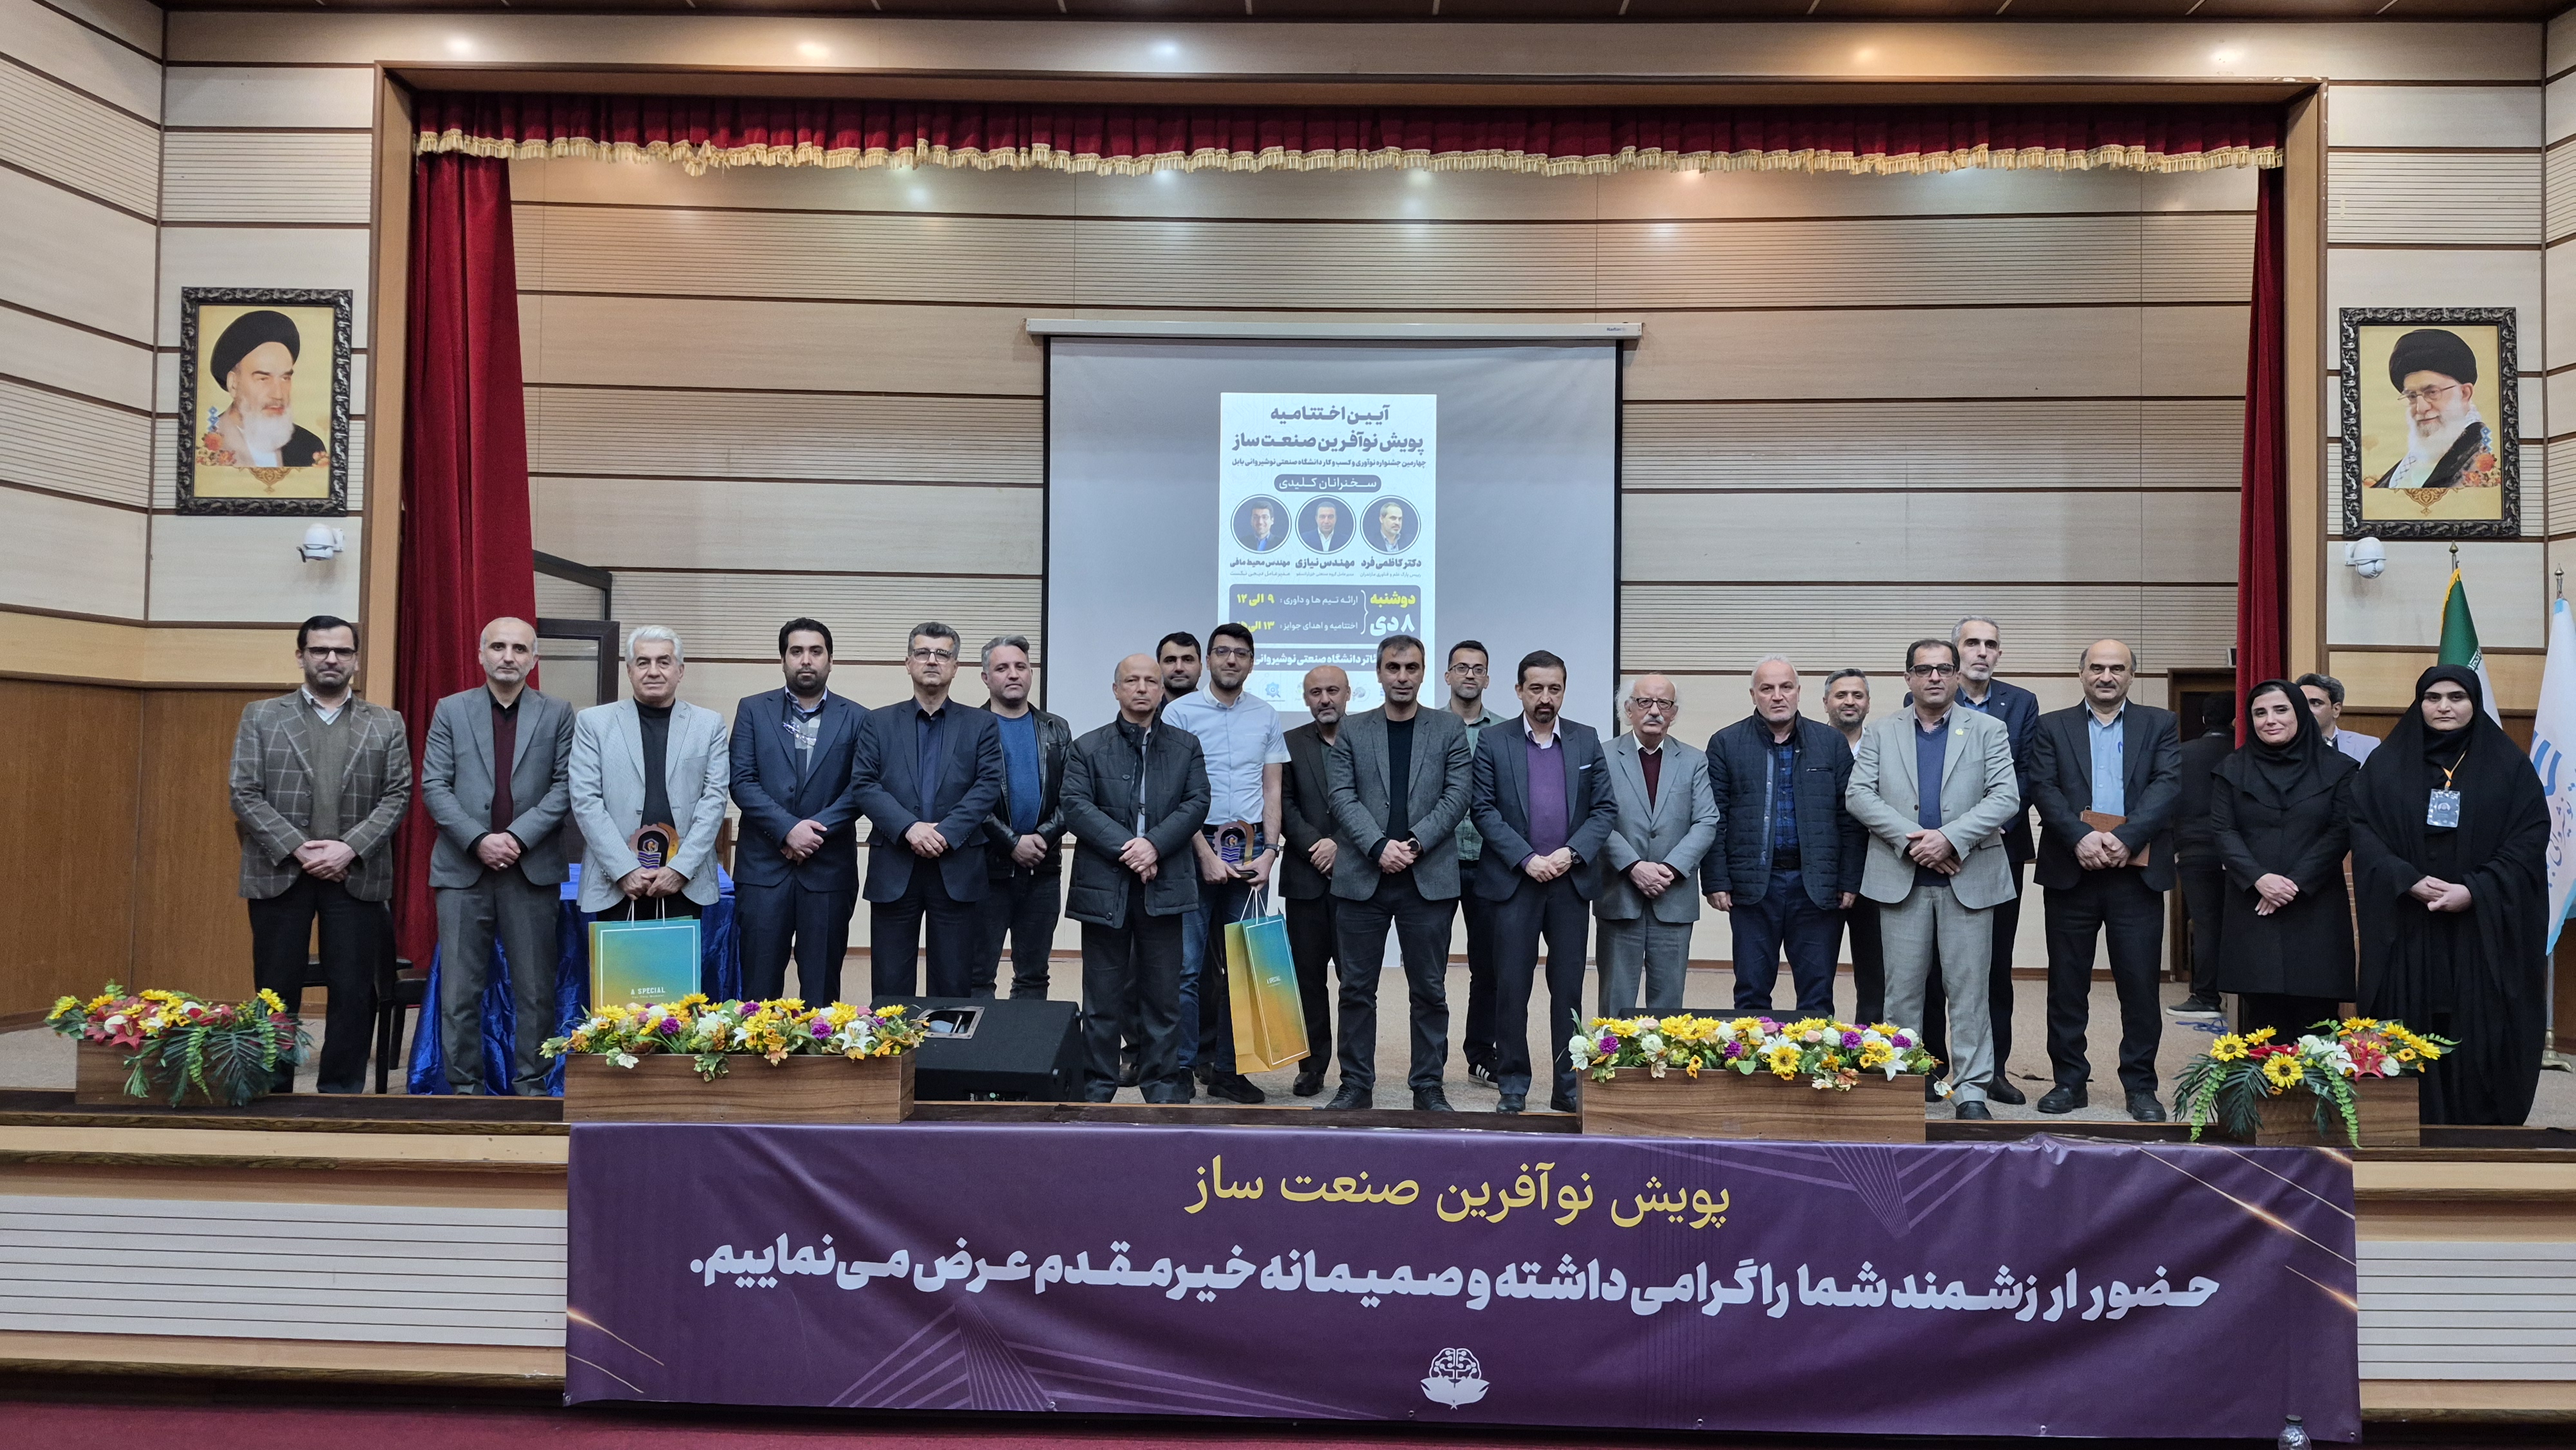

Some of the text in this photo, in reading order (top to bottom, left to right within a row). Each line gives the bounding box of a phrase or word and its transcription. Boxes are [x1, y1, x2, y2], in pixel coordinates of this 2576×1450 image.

[1271, 405, 1390, 425] آیین اختتامیه
[1231, 429, 1425, 455] پویش نوآفرین صنعت ساز
[1244, 458, 1276, 467] نوشیروانی
[1336, 459, 1352, 467] کسب
[1356, 458, 1376, 467] نوآوری
[1376, 459, 1401, 467] جشنواره
[1401, 459, 1426, 469] چهارمین
[1278, 476, 1377, 491] سخنرانان کلیدی
[1229, 557, 1291, 568] مهندس محیط مافی
[1295, 557, 1355, 569] مهندس نیازی
[1361, 556, 1422, 569] دکتر کاظمی فرد
[1249, 594, 1264, 607] الی
[1283, 596, 1304, 605] داوری
[1322, 596, 1340, 606] تیم
[1341, 596, 1358, 606] ارائه
[1370, 590, 1416, 608] دوشنبه
[1283, 623, 1301, 631] جوایز
[1302, 621, 1323, 630] اهدای
[1329, 621, 1358, 630] اختتامیه
[1370, 614, 1416, 637] ۸ دی
[1255, 653, 1297, 666] نوشیروانی
[1297, 654, 1327, 666] صنعتی
[1328, 654, 1361, 665] دانشگاه
[638, 986, 666, 995] SPECIAL
[1184, 1154, 1264, 1214] ساز
[1280, 1171, 1420, 1206] صنعت
[1611, 1174, 1730, 1229] پویش
[913, 1236, 1032, 1294] عرض
[1260, 1248, 1464, 1308] صمیمانه
[1495, 1252, 1627, 1302] داشته
[1465, 1268, 1492, 1311] و
[1630, 1257, 1759, 1317] گرامی
[1759, 1261, 1790, 1319] را
[1796, 1260, 1888, 1308] شما
[1890, 1264, 2078, 1323] ارزشمند
[2081, 1265, 2221, 1322] حضور
